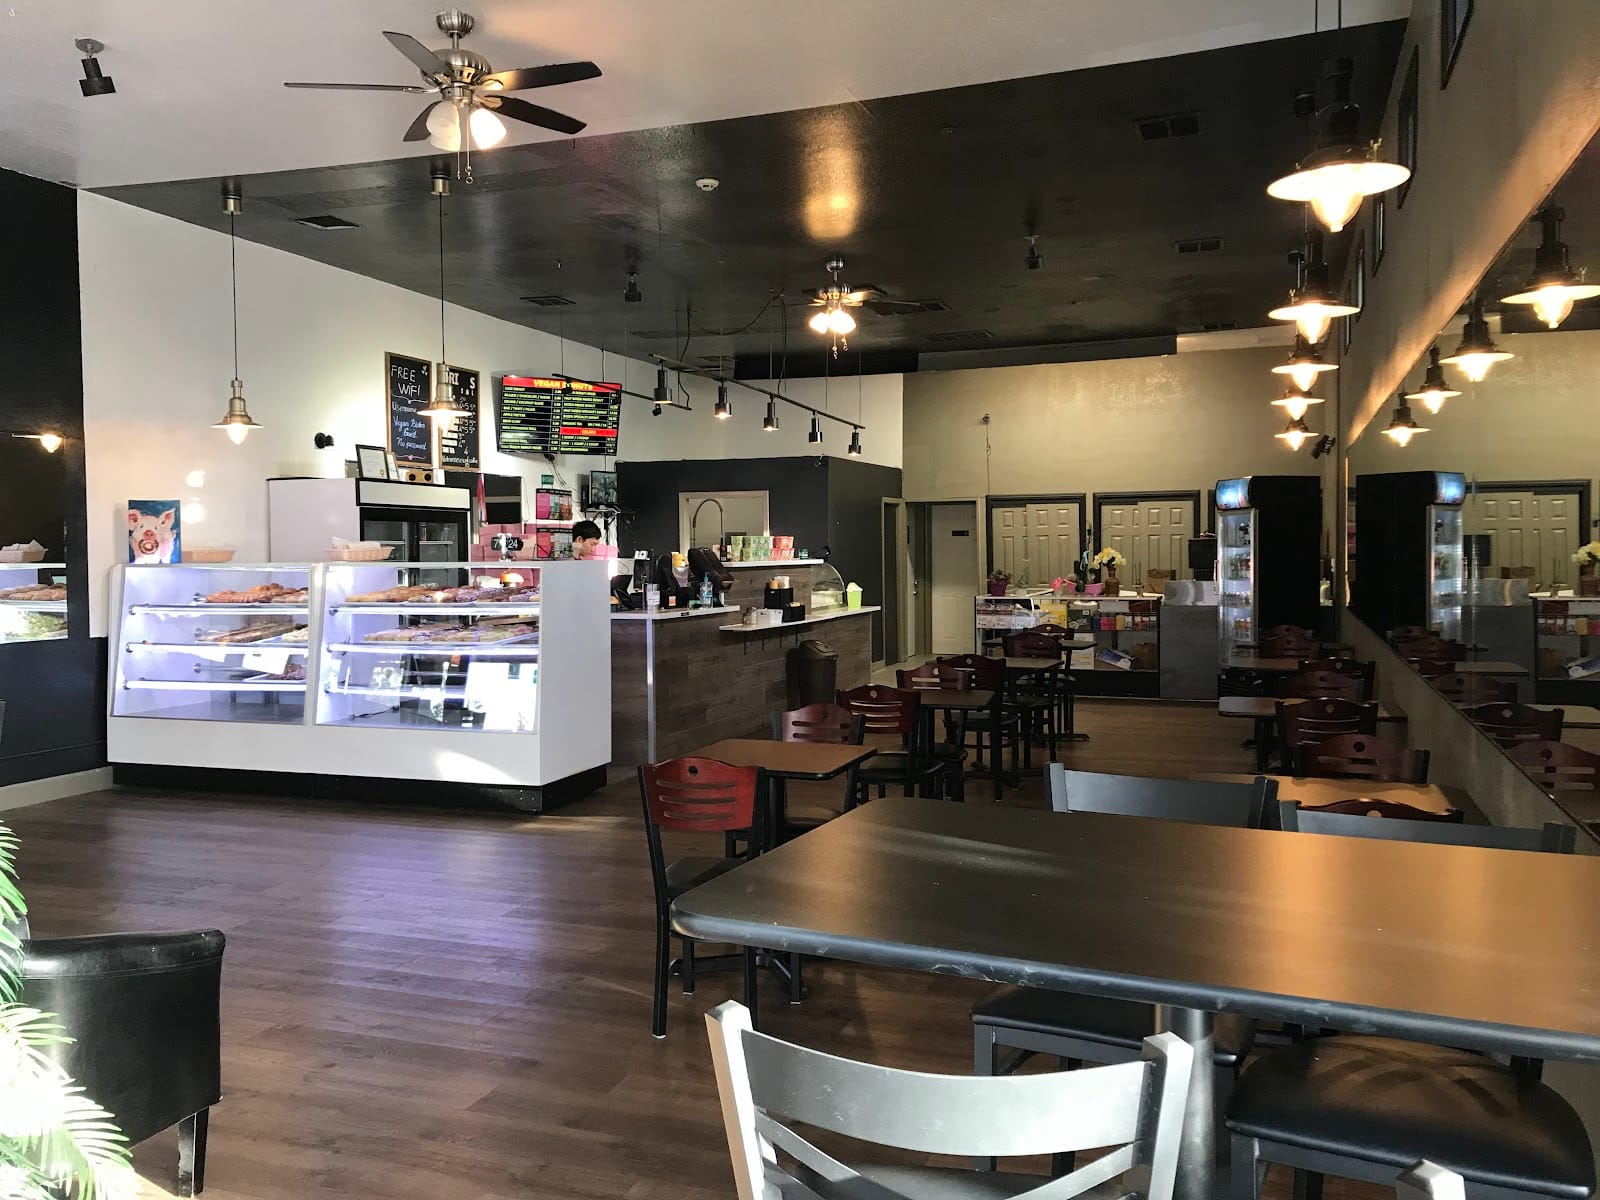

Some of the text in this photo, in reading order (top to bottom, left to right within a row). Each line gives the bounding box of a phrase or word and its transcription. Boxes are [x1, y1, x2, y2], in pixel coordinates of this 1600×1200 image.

[391, 365, 416, 382] FREE
[534, 379, 560, 389] VEGAN
[508, 538, 518, 549] 24
